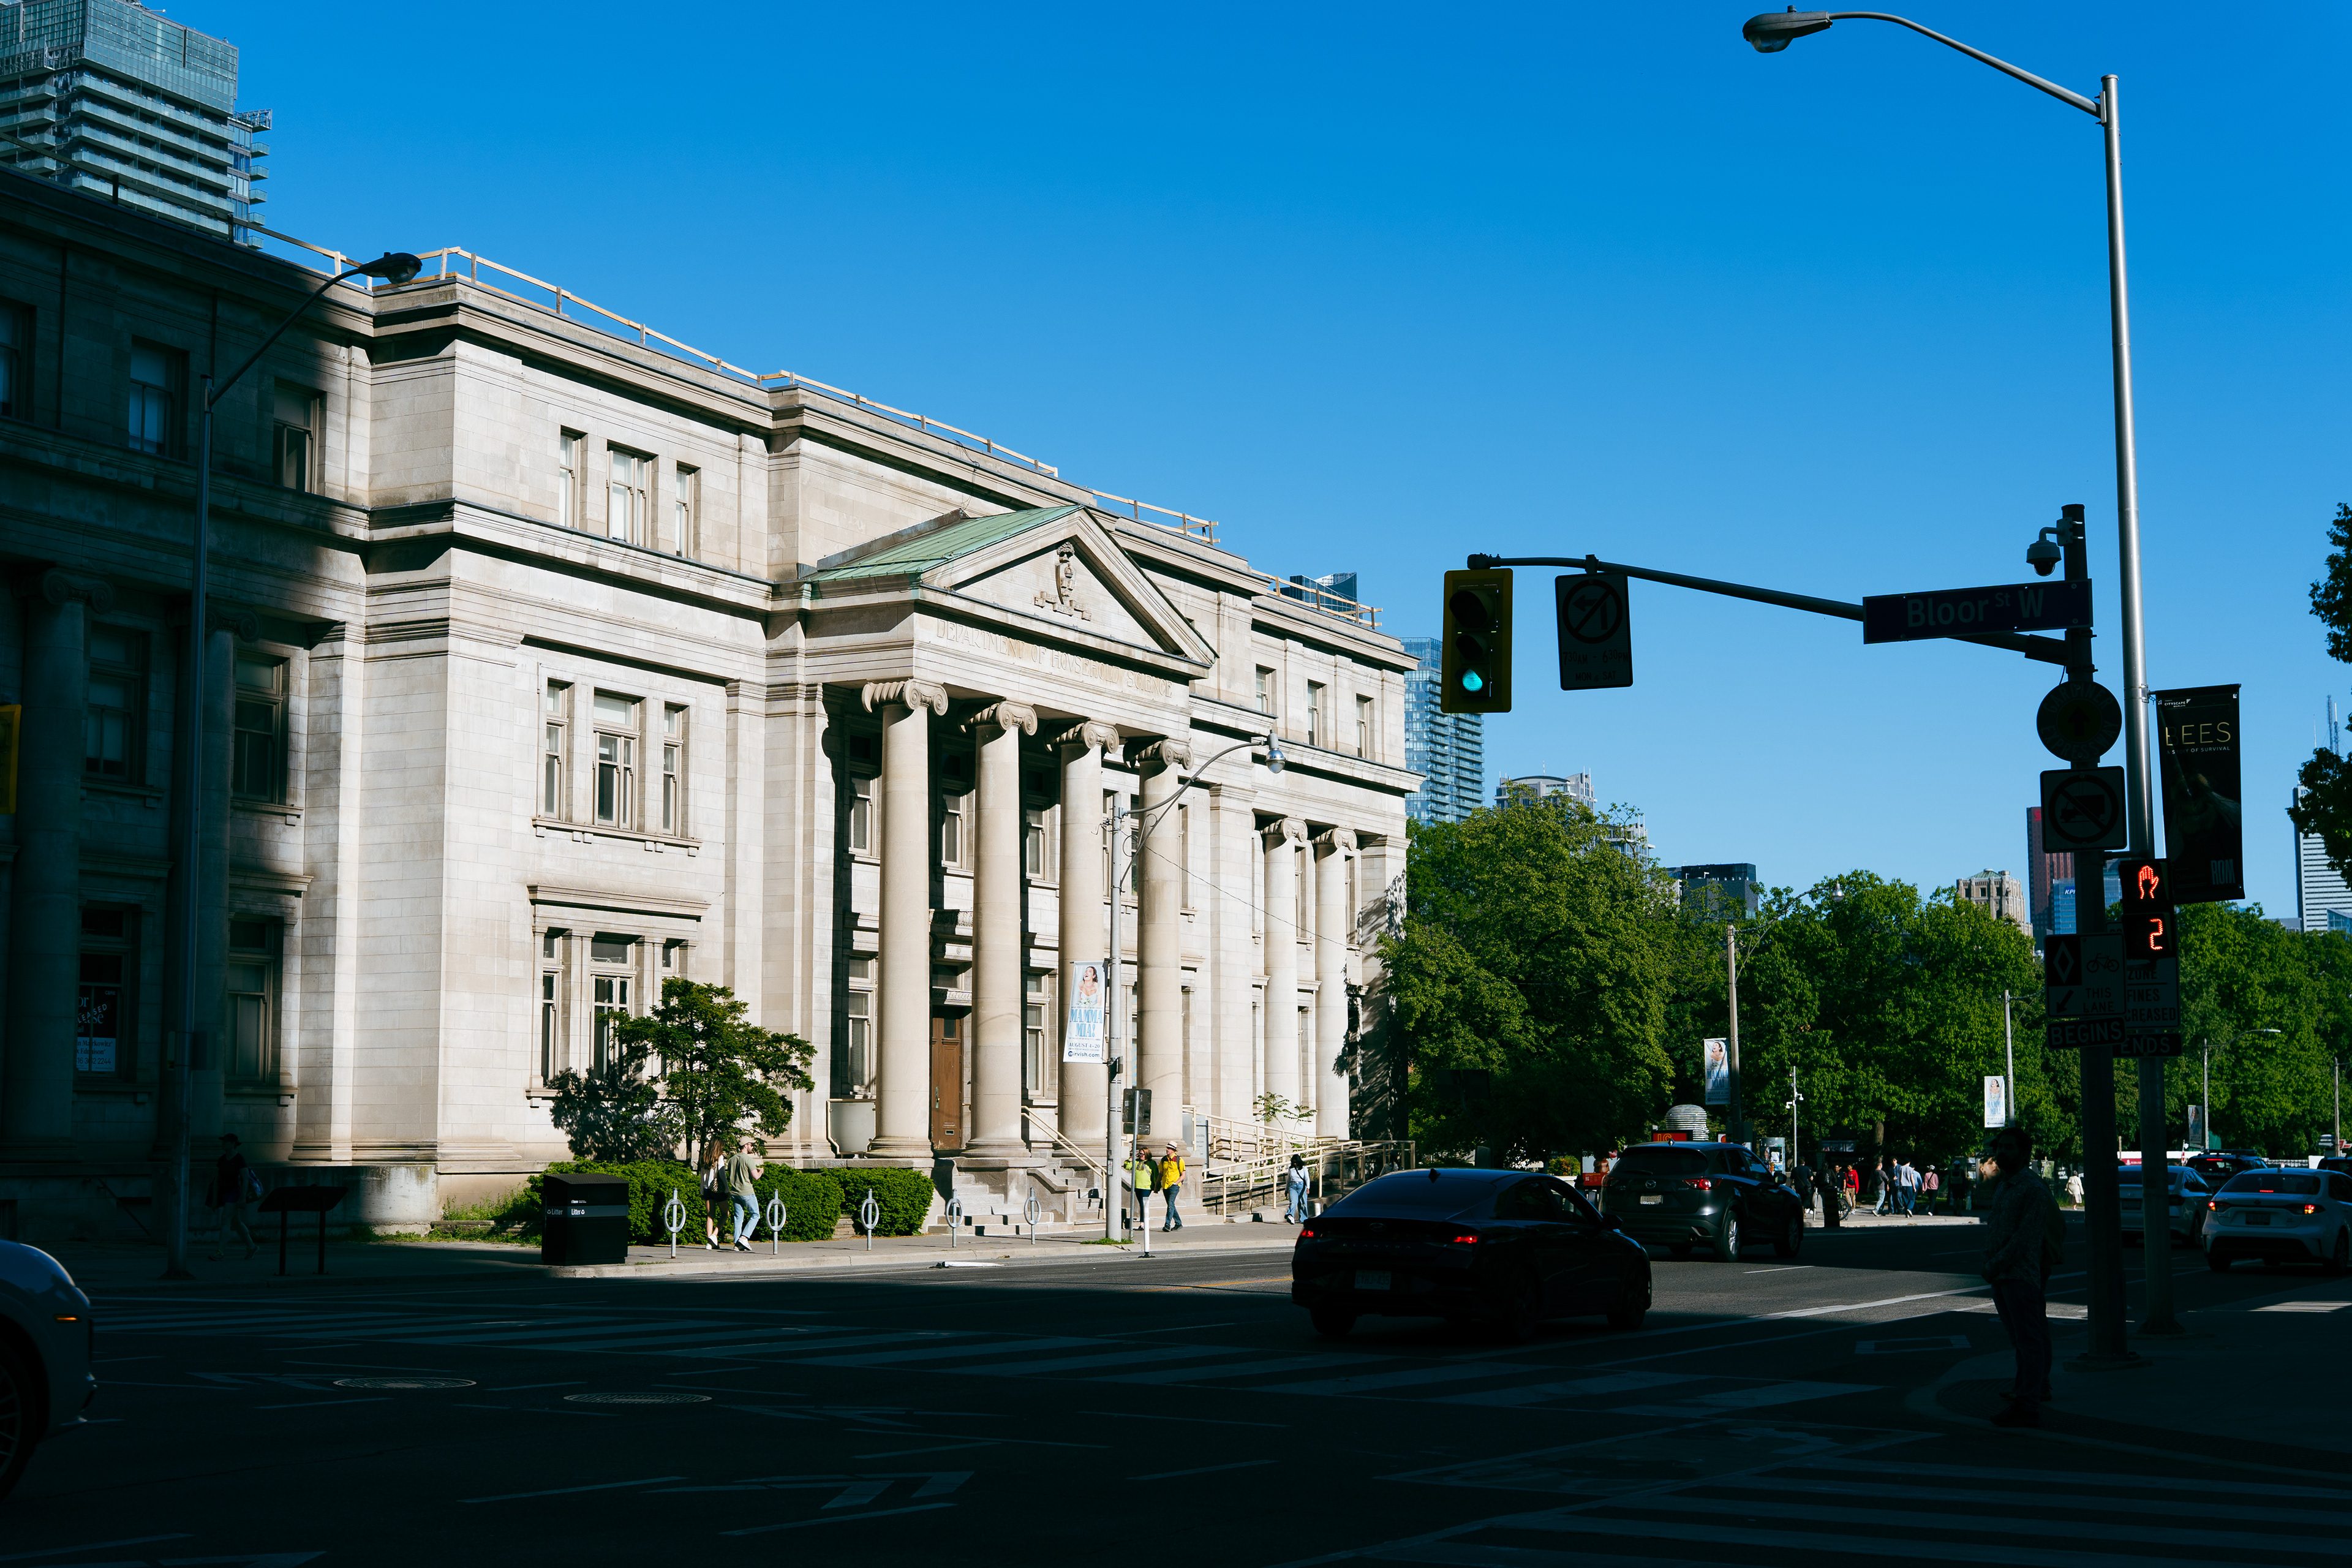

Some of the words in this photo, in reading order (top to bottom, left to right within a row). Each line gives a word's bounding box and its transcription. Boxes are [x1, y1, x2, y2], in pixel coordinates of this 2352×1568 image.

[1906, 598, 1989, 628] Bloor
[1995, 592, 2011, 608] St
[2018, 588, 2045, 619] W
[937, 619, 1025, 660] DEPARTMENT
[1030, 644, 1047, 665] OF
[1127, 669, 1173, 698] SCIENCE
[1575, 671, 1592, 682] MON
[1602, 671, 1616, 681] SAT
[2165, 722, 2231, 747] BEES
[2149, 918, 2163, 951] 2
[2085, 987, 2112, 999] THIS
[2127, 988, 2160, 1003] FINES
[78, 996, 89, 1008] or
[2083, 1001, 2114, 1014] LANE
[77, 1003, 108, 1023] LEASED
[1069, 1009, 1102, 1023] MAMMA
[2125, 1007, 2176, 1022] CREASED
[1075, 1023, 1096, 1038] MIA!
[2051, 1020, 2123, 1047] BEGINS
[2120, 1036, 2171, 1054] ENDS
